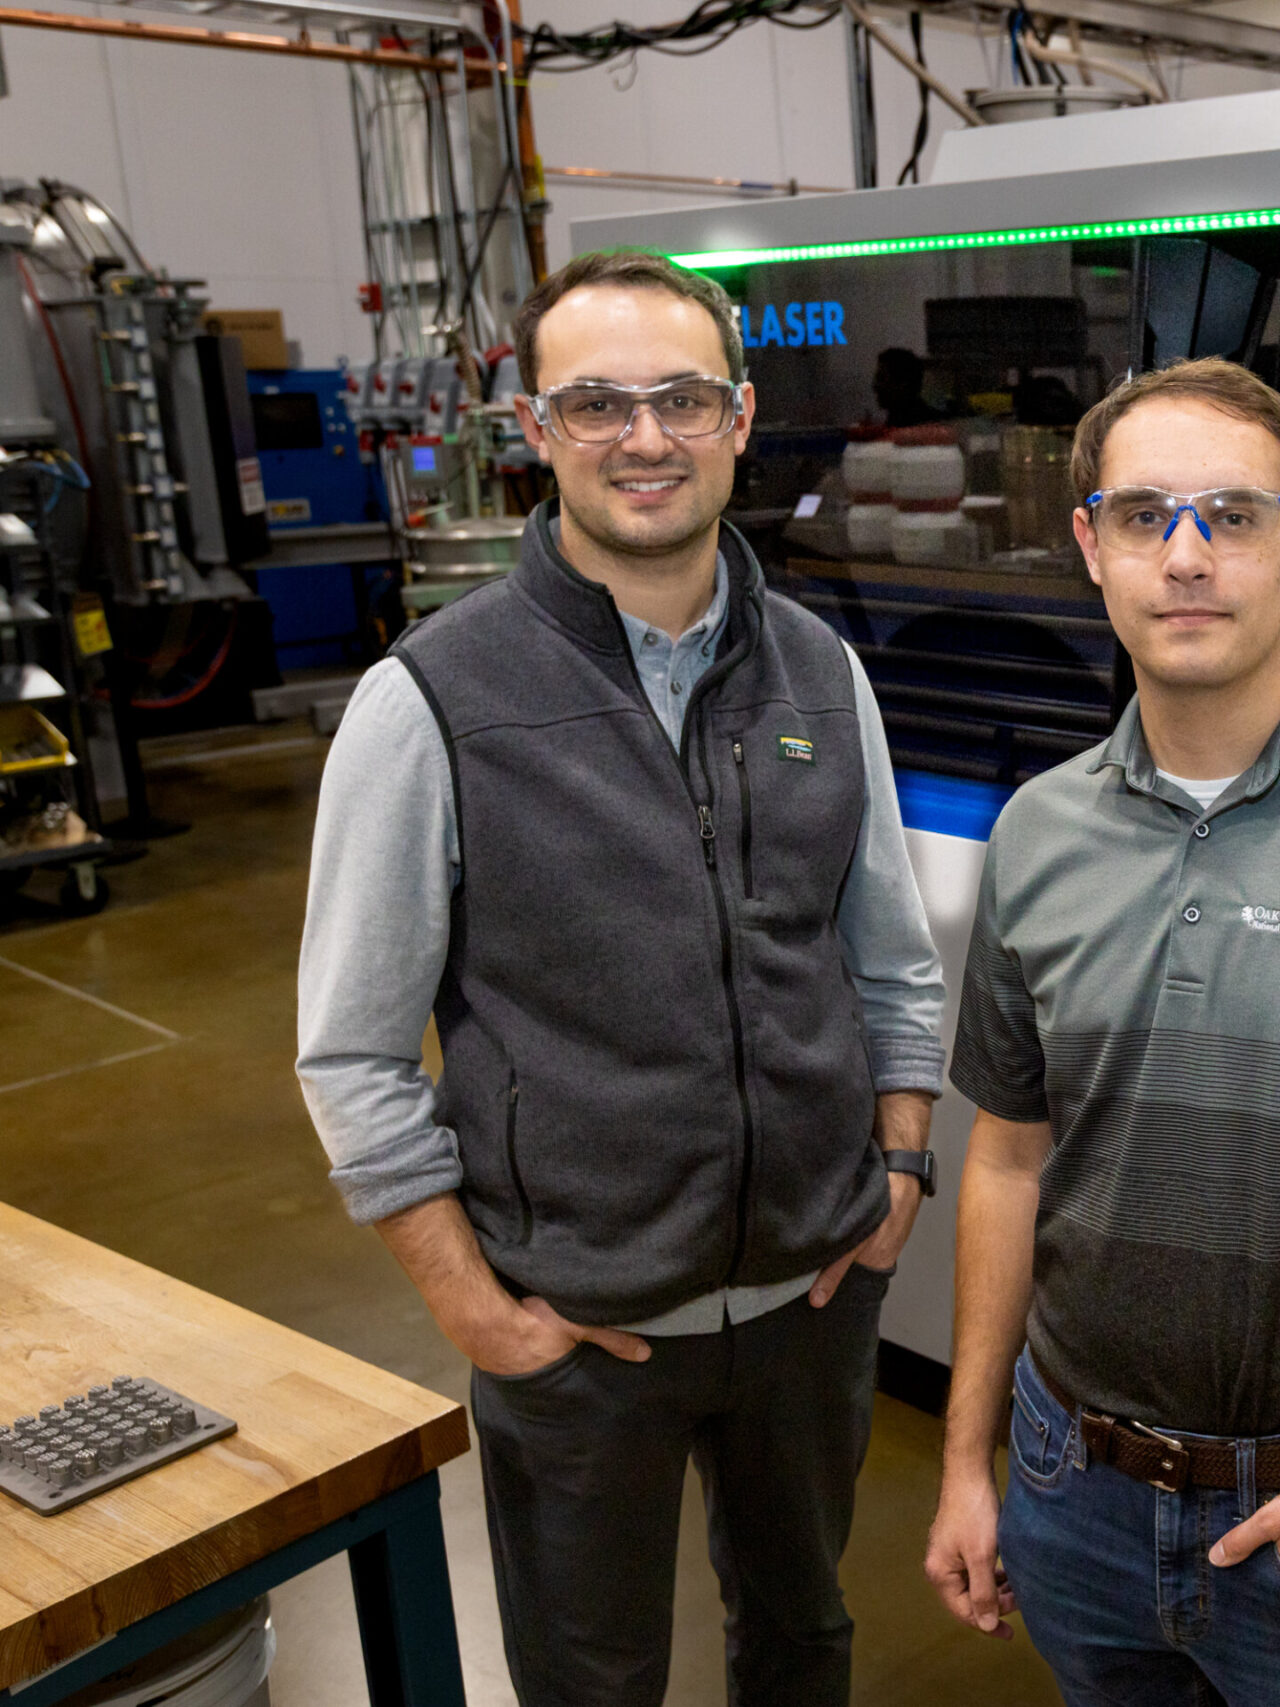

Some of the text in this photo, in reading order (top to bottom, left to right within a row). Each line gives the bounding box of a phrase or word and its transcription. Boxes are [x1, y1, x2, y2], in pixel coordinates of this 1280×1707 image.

[741, 301, 848, 348] LASER
[1254, 906, 1280, 921] OAK
[1251, 920, 1280, 932] National
